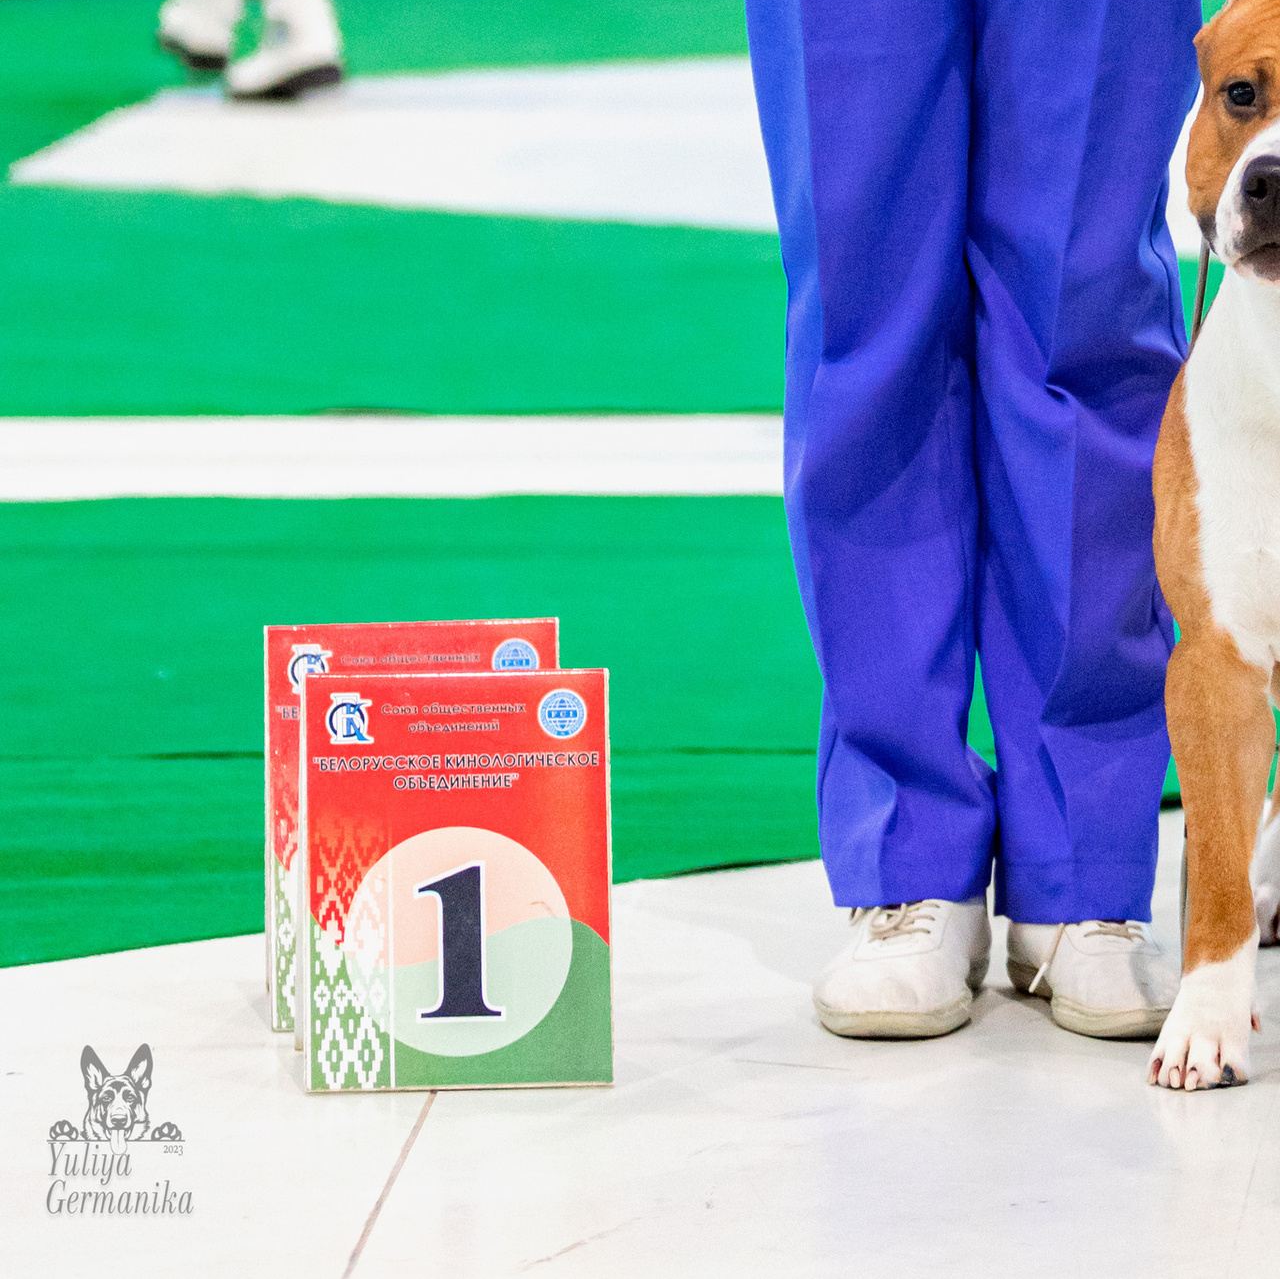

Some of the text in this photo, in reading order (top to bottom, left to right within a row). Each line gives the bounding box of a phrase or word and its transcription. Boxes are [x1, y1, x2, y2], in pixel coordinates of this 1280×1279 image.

[381, 702, 526, 715] Союз общественных
[551, 709, 576, 718] FCI
[408, 719, 500, 733] объединений
[313, 750, 599, 772] "БЕЛОРУССКОЕ КИНОЛОГИЧЕСКОЕ
[394, 773, 519, 791] ОБЪЕДИНЕНИЕ"
[414, 861, 505, 1022] 1
